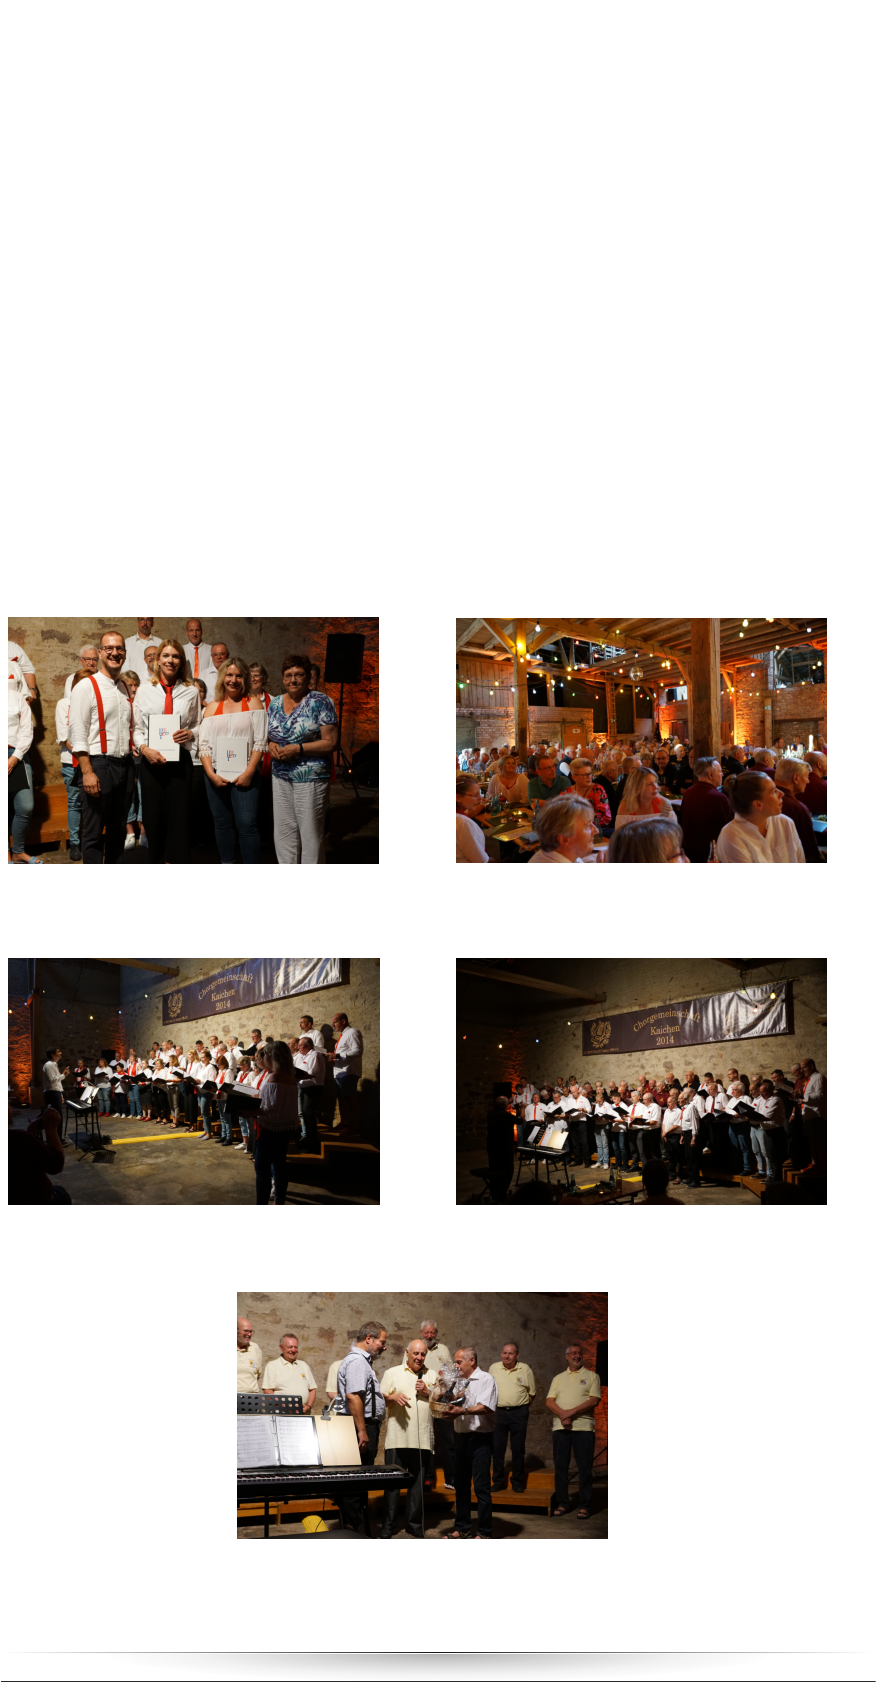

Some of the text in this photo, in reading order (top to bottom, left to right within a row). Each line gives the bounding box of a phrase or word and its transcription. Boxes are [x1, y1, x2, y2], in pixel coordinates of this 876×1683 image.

[198, 972, 254, 1000] Chorgemeinschaft
[211, 988, 236, 1002] Kaichen
[215, 999, 231, 1011] 2014
[633, 1008, 701, 1033] Chorgemeinschaft
[650, 1024, 681, 1036] Kaichen
[656, 1035, 675, 1046] 2014
